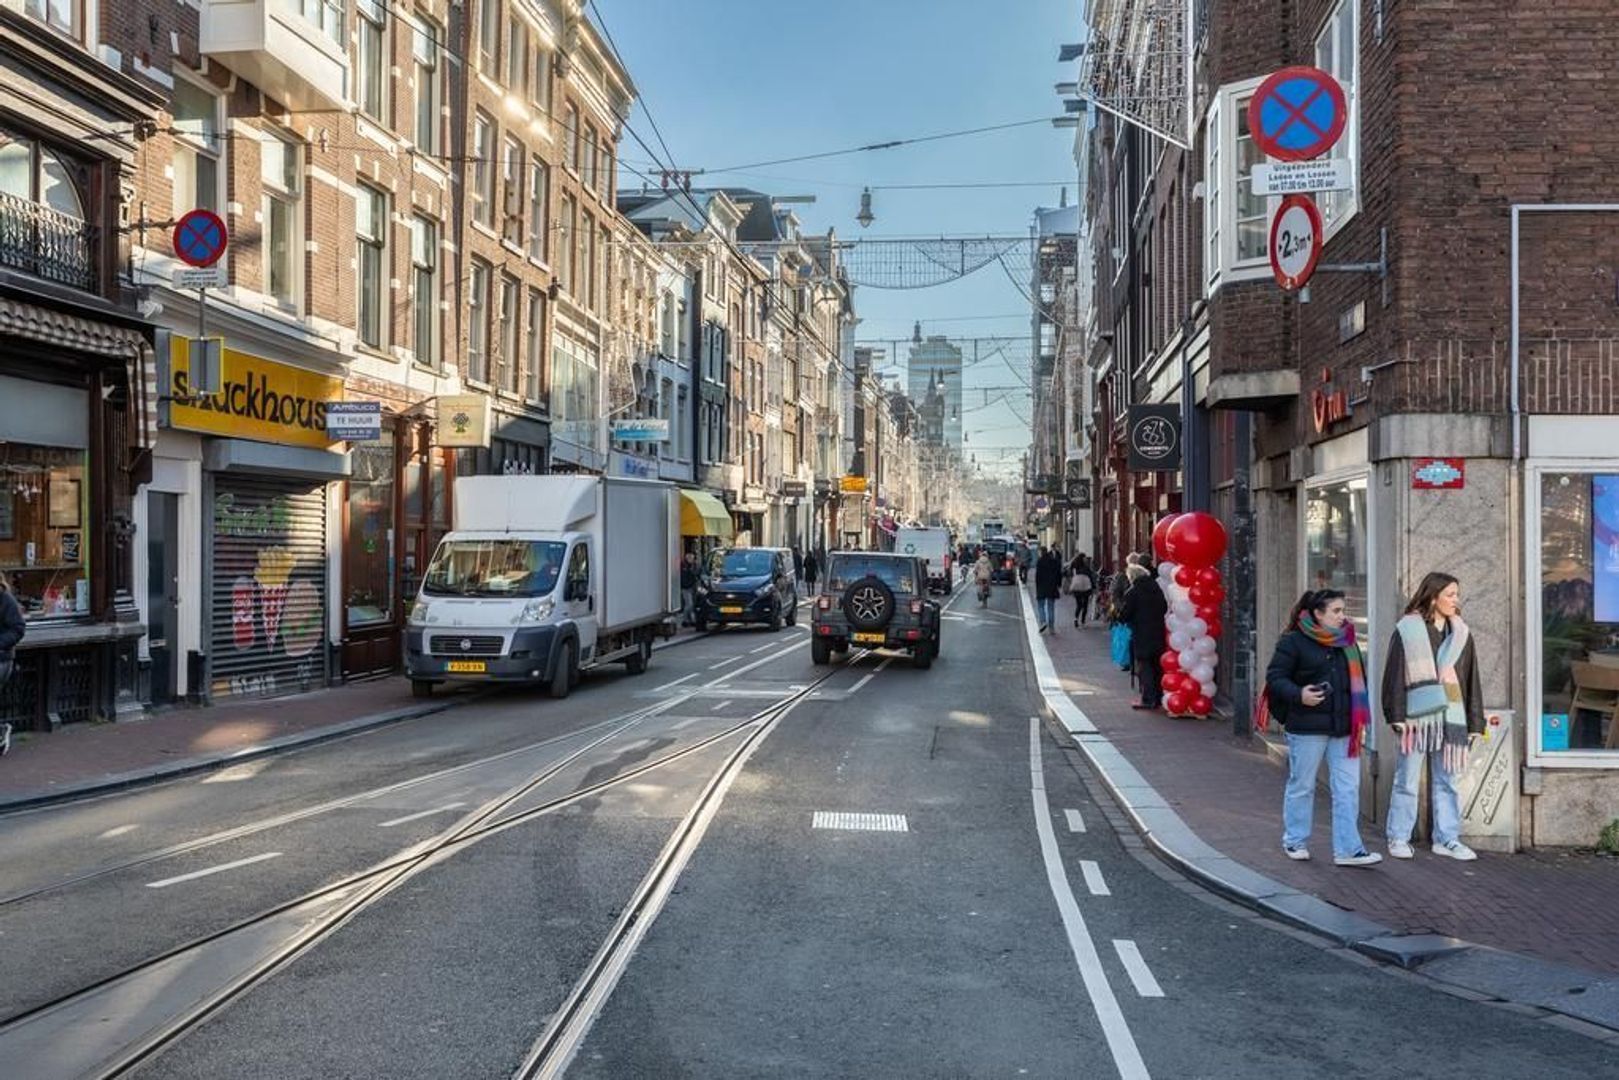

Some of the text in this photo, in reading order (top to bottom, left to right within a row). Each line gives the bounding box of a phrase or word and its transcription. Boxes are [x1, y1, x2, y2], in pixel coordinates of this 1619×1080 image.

[1307, 171, 1336, 179] Lossen
[172, 371, 327, 431] sackhous
[336, 416, 373, 425] TE HUUR
